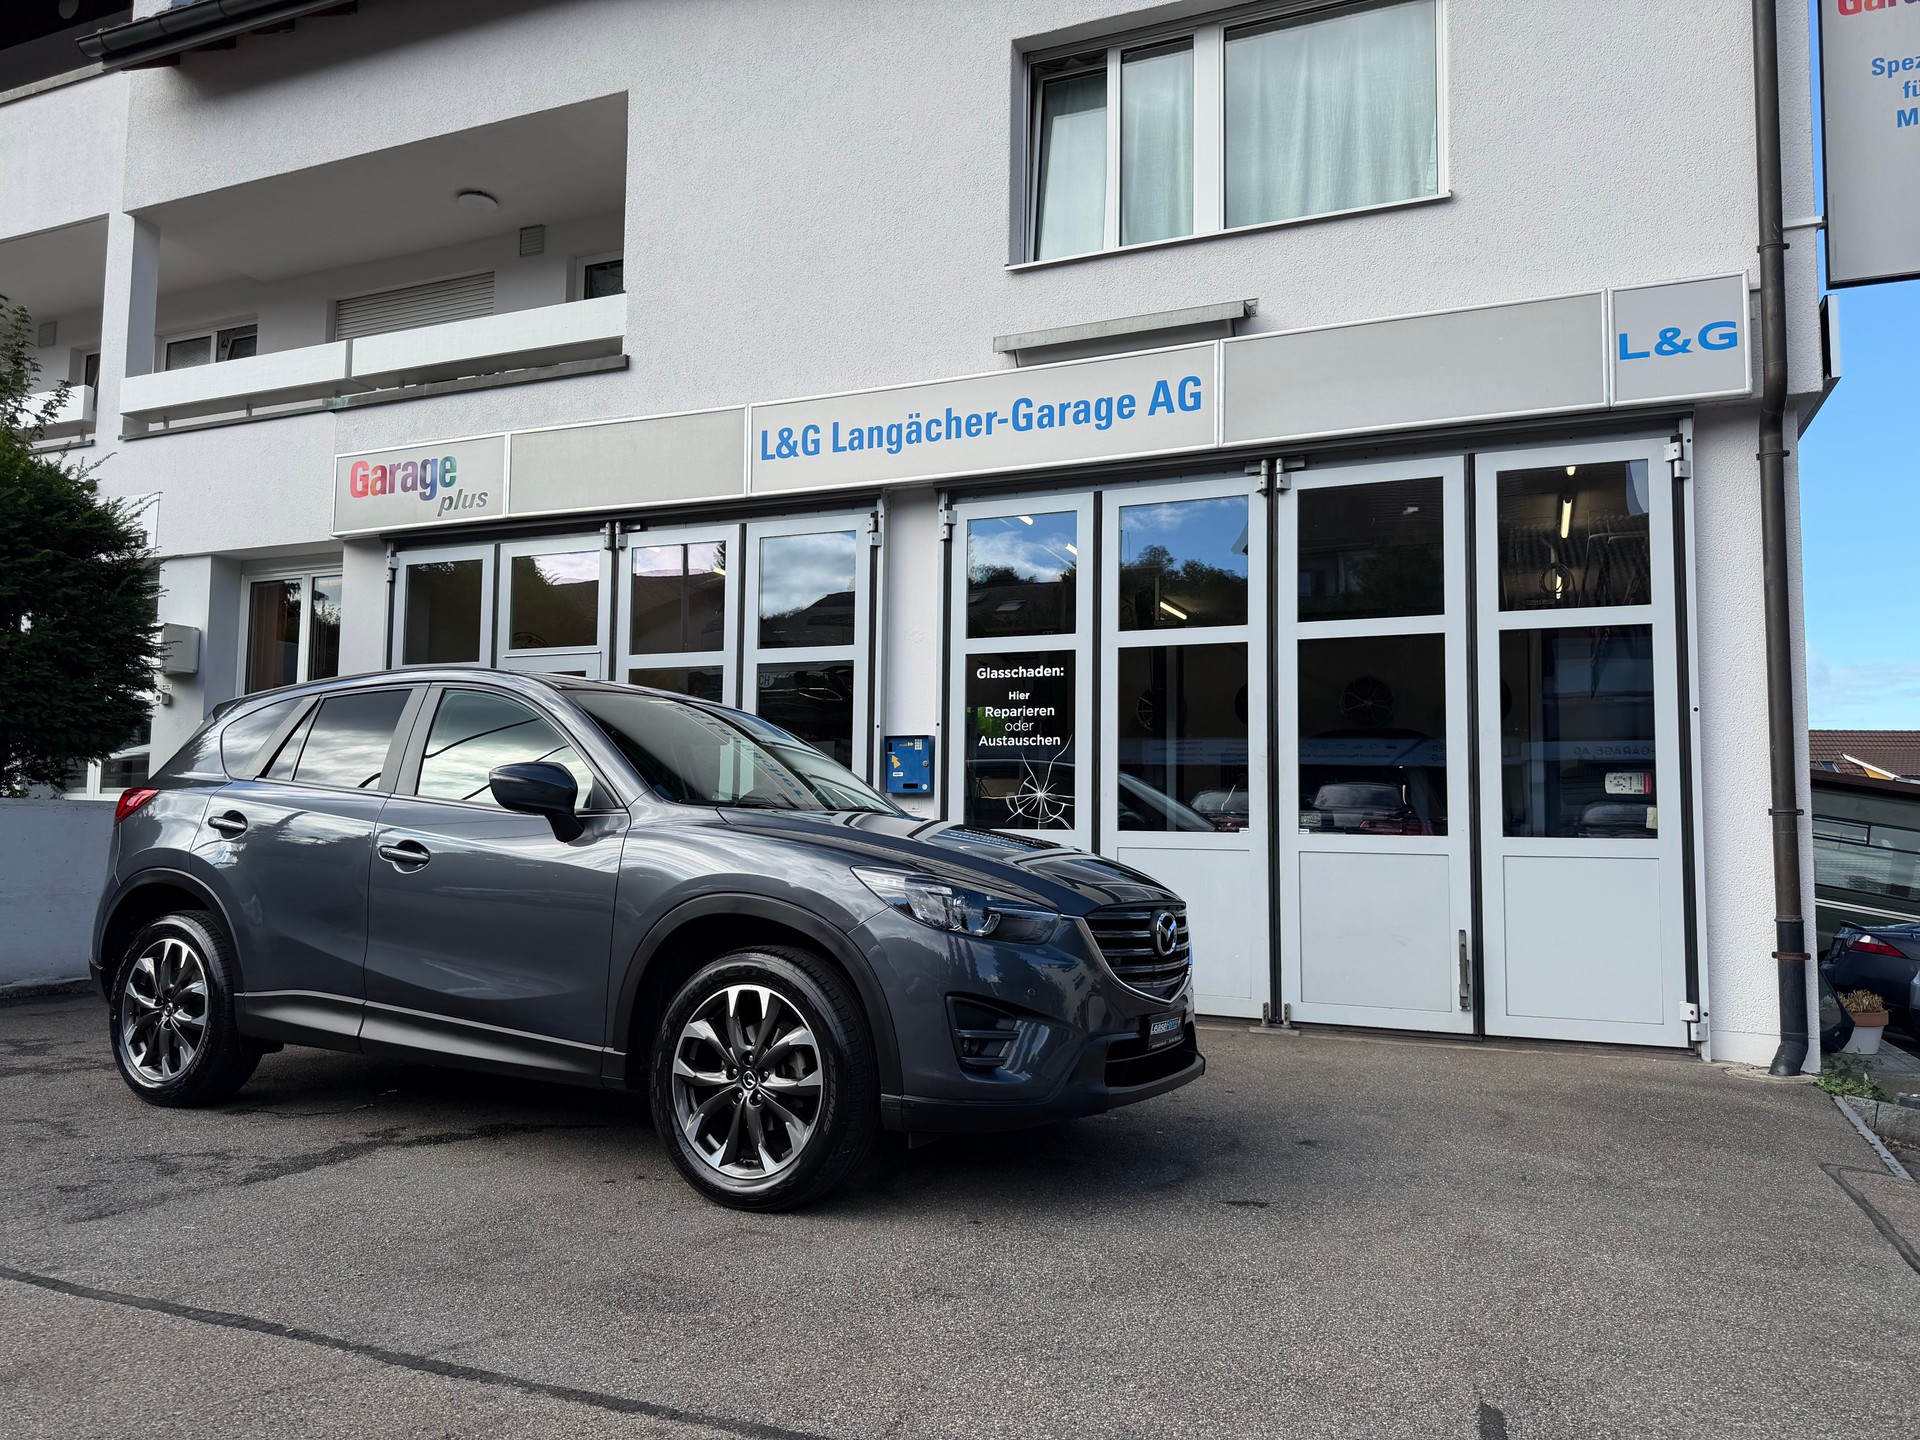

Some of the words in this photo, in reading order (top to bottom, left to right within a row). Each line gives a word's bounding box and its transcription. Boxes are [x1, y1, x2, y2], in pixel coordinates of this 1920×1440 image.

[1618, 320, 1738, 360] L&G
[760, 424, 821, 461] L&G
[832, 392, 1136, 454] Langächer-Garage
[1147, 375, 1203, 417] AG
[350, 455, 457, 502] Garage
[437, 488, 488, 517] plus
[976, 665, 1064, 679] Glasschaden:
[1008, 691, 1030, 700] Hier
[985, 706, 1055, 719] Reparieren
[1004, 720, 1034, 732] oder
[978, 735, 1061, 746] Austauschen
